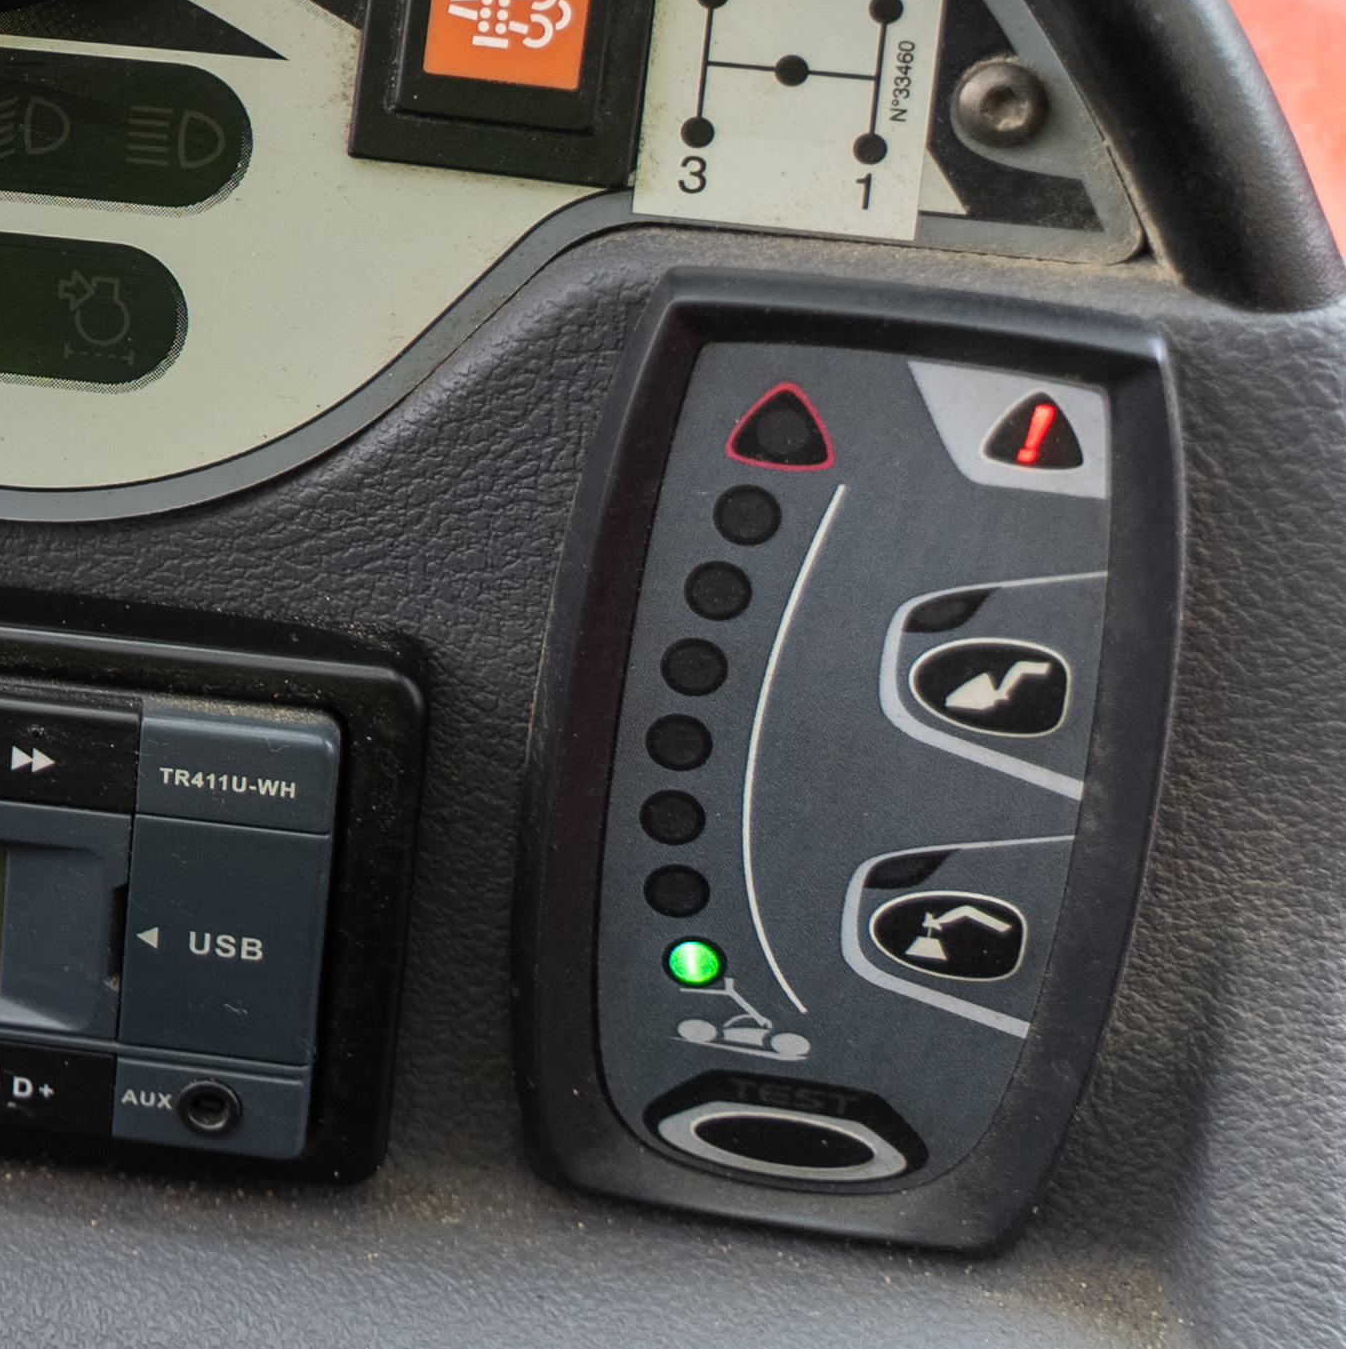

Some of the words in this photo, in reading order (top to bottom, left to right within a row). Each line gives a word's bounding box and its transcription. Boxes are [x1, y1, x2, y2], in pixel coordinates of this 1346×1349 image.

[677, 155, 707, 194] 3
[854, 172, 873, 210] 1
[160, 767, 297, 800] TR411U-WH
[188, 932, 264, 962] USB
[121, 1088, 172, 1111] AUX
